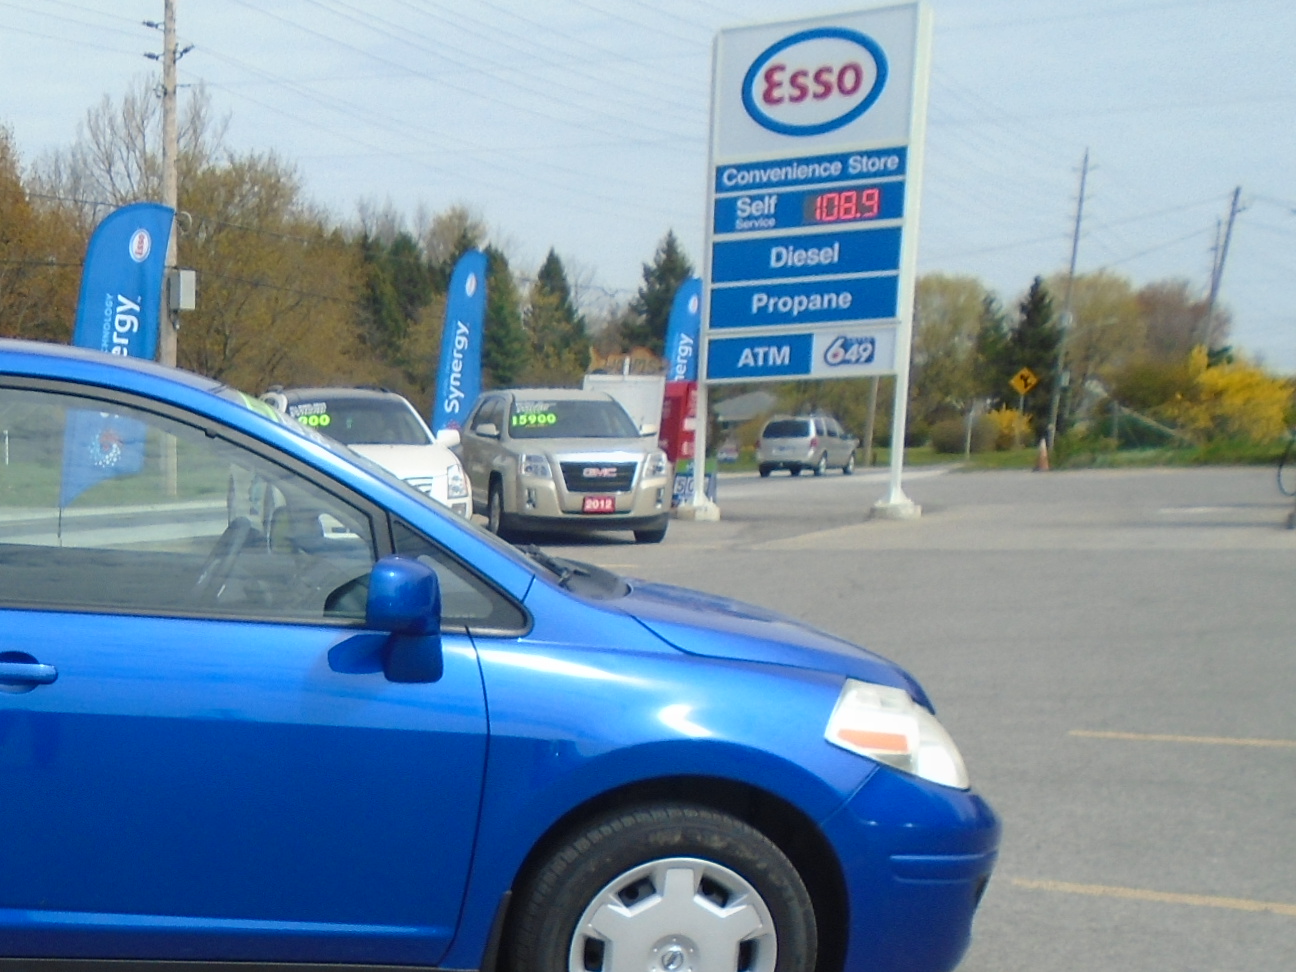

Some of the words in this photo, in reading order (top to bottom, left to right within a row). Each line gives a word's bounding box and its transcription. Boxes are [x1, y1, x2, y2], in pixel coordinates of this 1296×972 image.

[722, 160, 842, 187] Convenience
[848, 153, 899, 174] Store
[736, 194, 778, 215] Self
[814, 187, 880, 222] 108.9
[735, 216, 776, 230] Service
[769, 241, 840, 268] Diesel
[751, 291, 853, 316] Propane
[444, 320, 469, 413] Synergy
[737, 345, 791, 369] ATM
[512, 413, 557, 426] 15900
[583, 467, 618, 478] GMC
[584, 498, 613, 510] 2012
